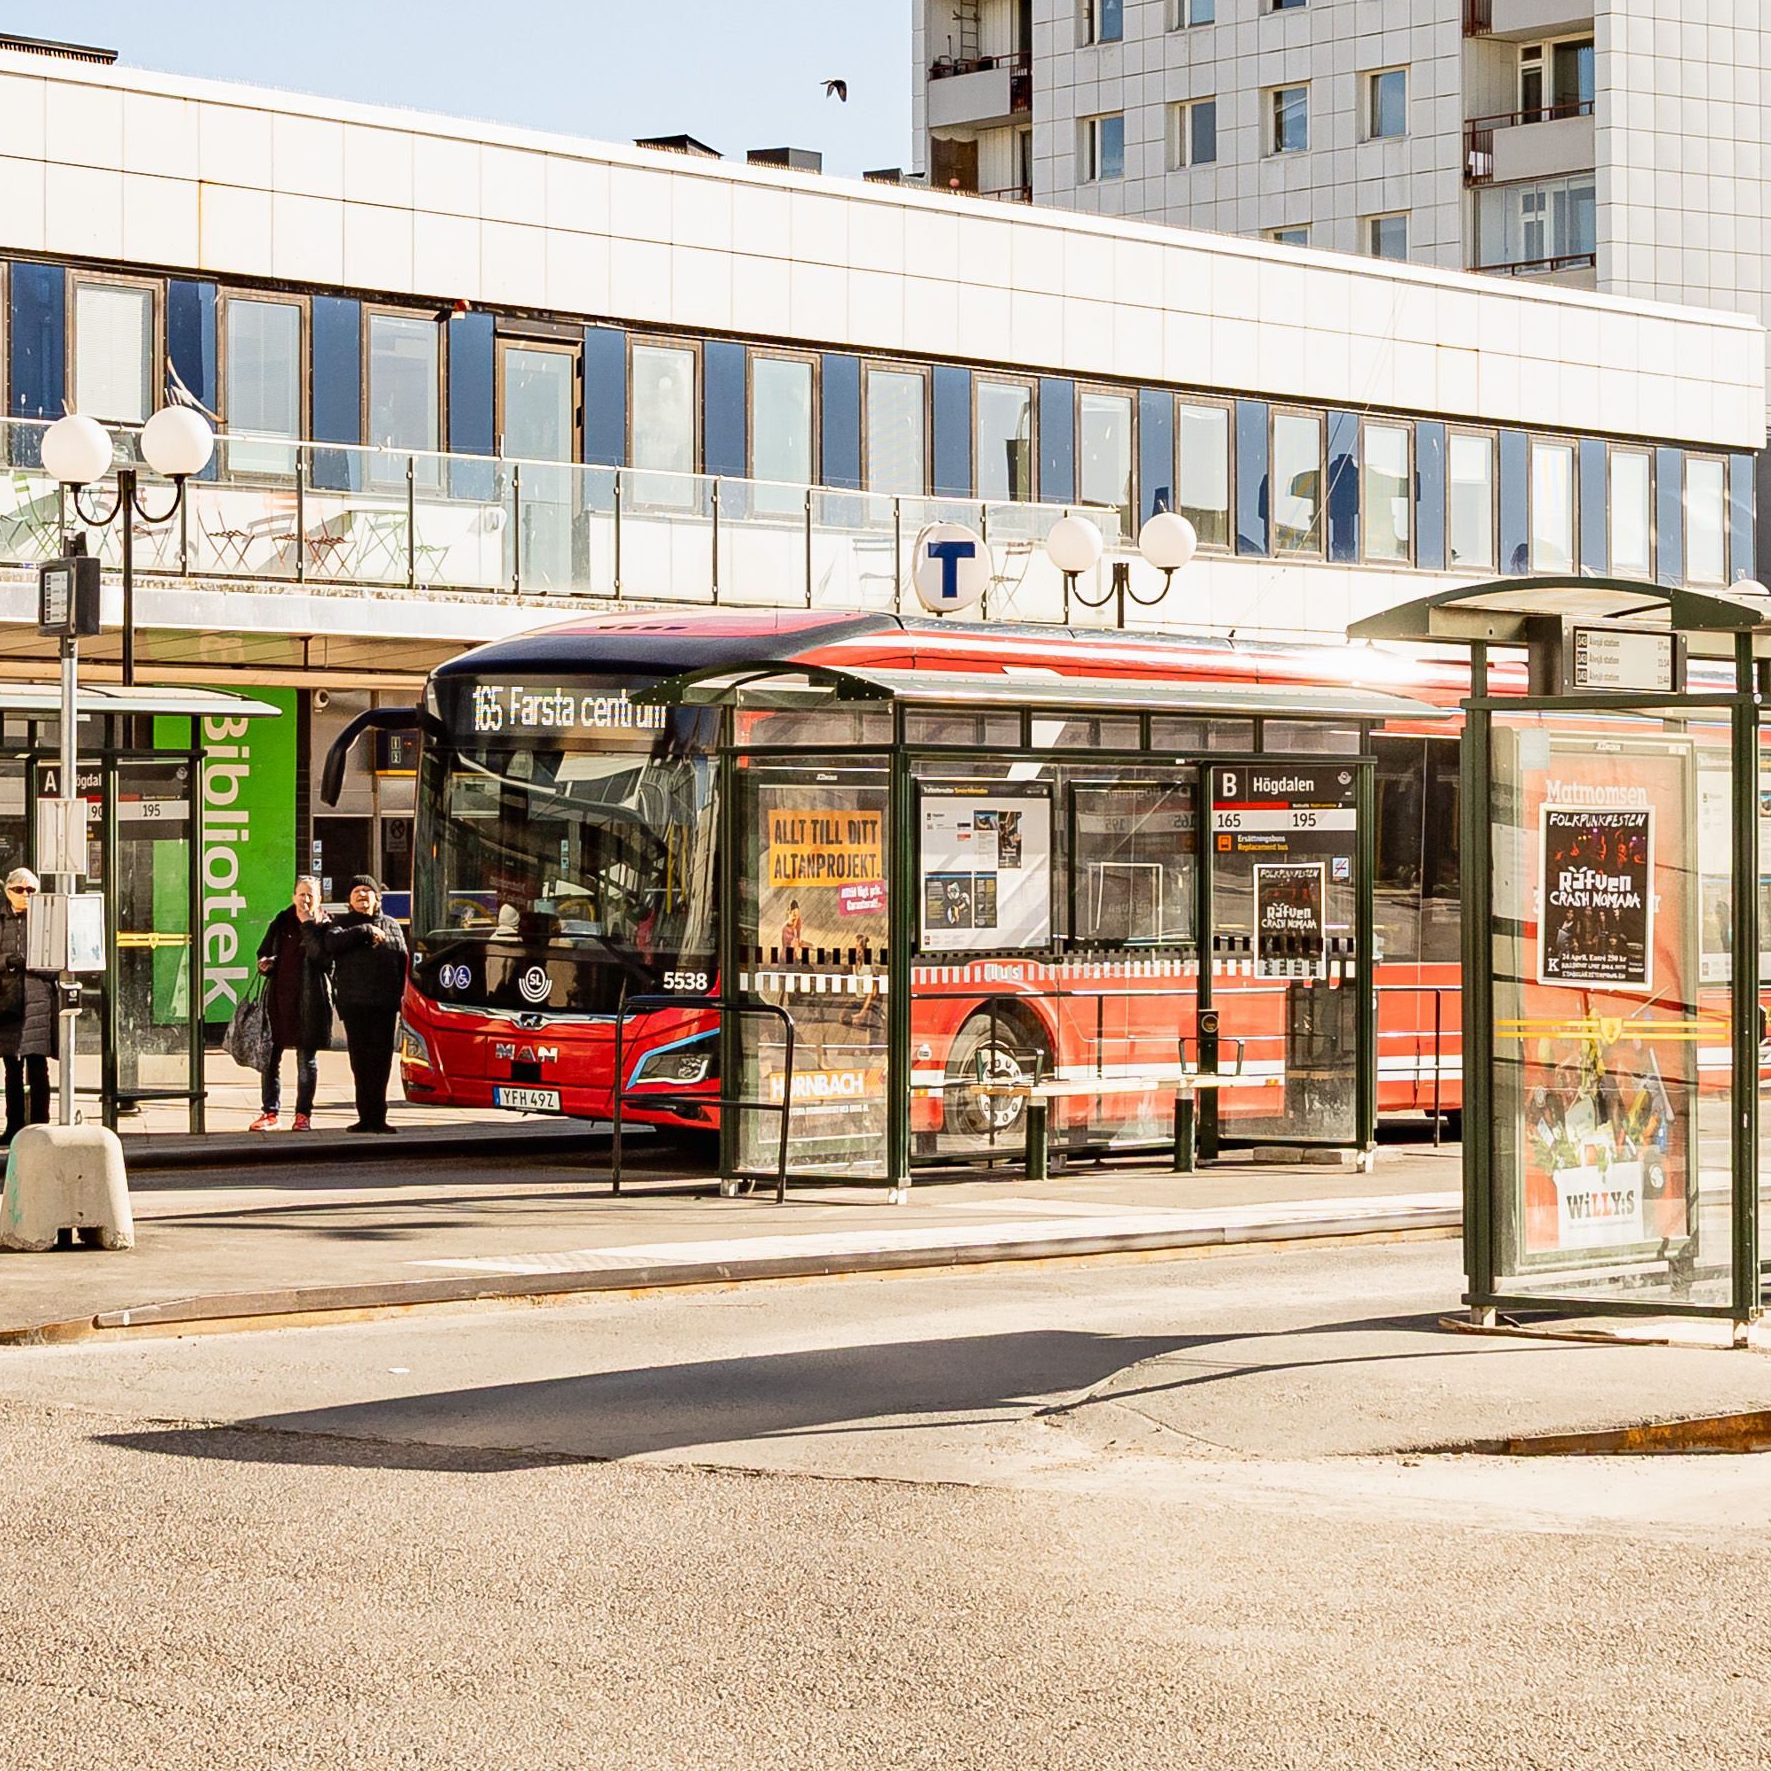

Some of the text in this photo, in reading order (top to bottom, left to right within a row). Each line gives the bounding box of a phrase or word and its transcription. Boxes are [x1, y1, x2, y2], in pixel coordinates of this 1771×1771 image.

[927, 541, 976, 598] T
[472, 685, 504, 731] 165
[509, 686, 575, 727] Farsta
[44, 770, 57, 792] A
[76, 772, 102, 789] ögdal
[1222, 772, 1237, 797] B
[1253, 776, 1315, 795] Högdalen
[1545, 779, 1648, 805] Matmomsen
[142, 804, 161, 817] 195
[1217, 813, 1317, 828] 165 195
[1549, 812, 1646, 828] FOLKPUNKFESTEN
[774, 819, 878, 844] ALLT TILL DITT
[774, 853, 881, 879] ALTANPROJEKT.
[1549, 891, 1641, 909] CRASH NOMADA
[1547, 957, 1560, 972] K
[663, 971, 708, 991] 5538
[495, 1043, 560, 1064] MAN
[503, 1088, 555, 1108] YFH 49Z
[1566, 1190, 1635, 1220] WiLLY:S
